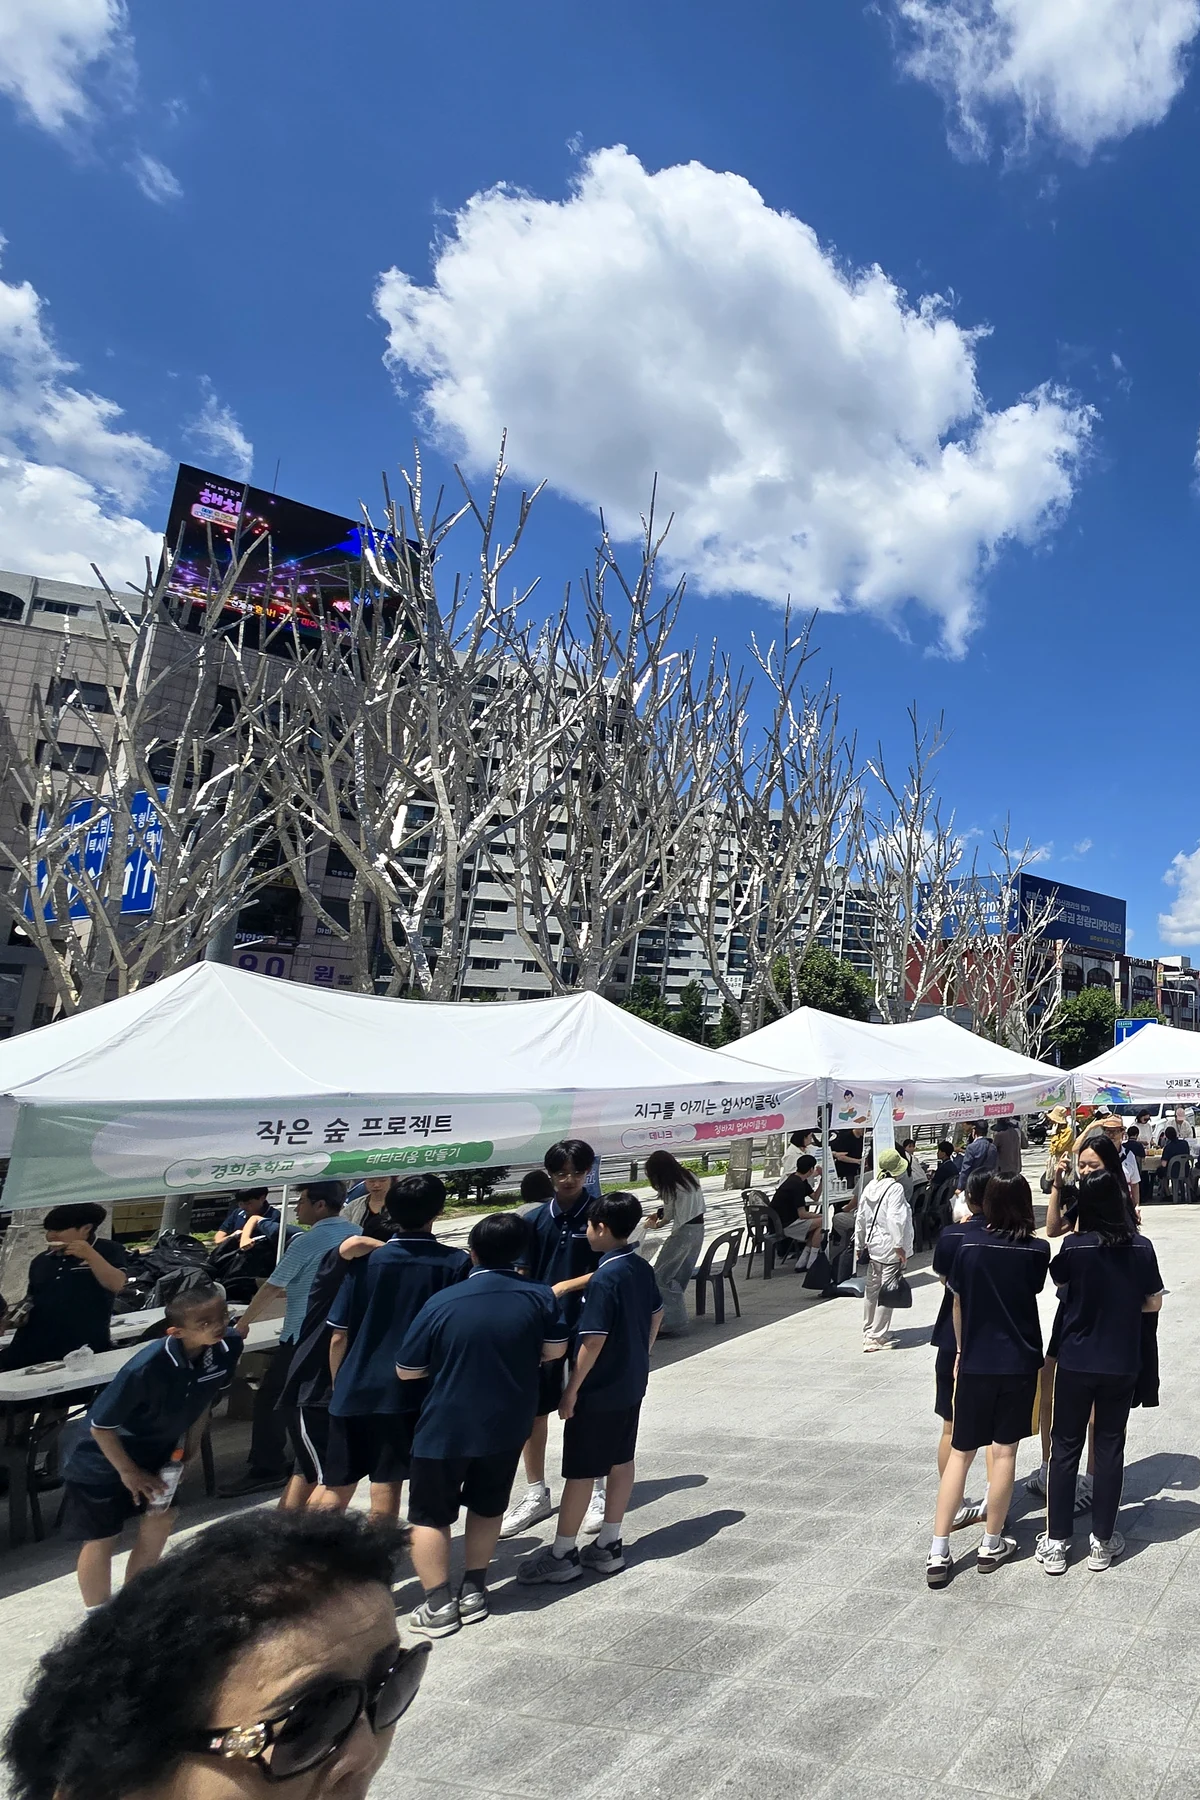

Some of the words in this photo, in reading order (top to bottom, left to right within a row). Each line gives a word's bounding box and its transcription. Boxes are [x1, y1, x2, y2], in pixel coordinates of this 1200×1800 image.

[634, 1101, 676, 1120] 지구를
[679, 1100, 718, 1116] 아끼는
[720, 1093, 781, 1115] 업사이클링!
[256, 1117, 314, 1146] 작은
[322, 1117, 350, 1144] 숲
[357, 1114, 453, 1138] 프로젝트
[736, 1119, 768, 1133] 업사이클링
[366, 1152, 420, 1165] 테라리움
[423, 1147, 461, 1163] 만들기
[210, 1160, 296, 1180] 경희중학교
